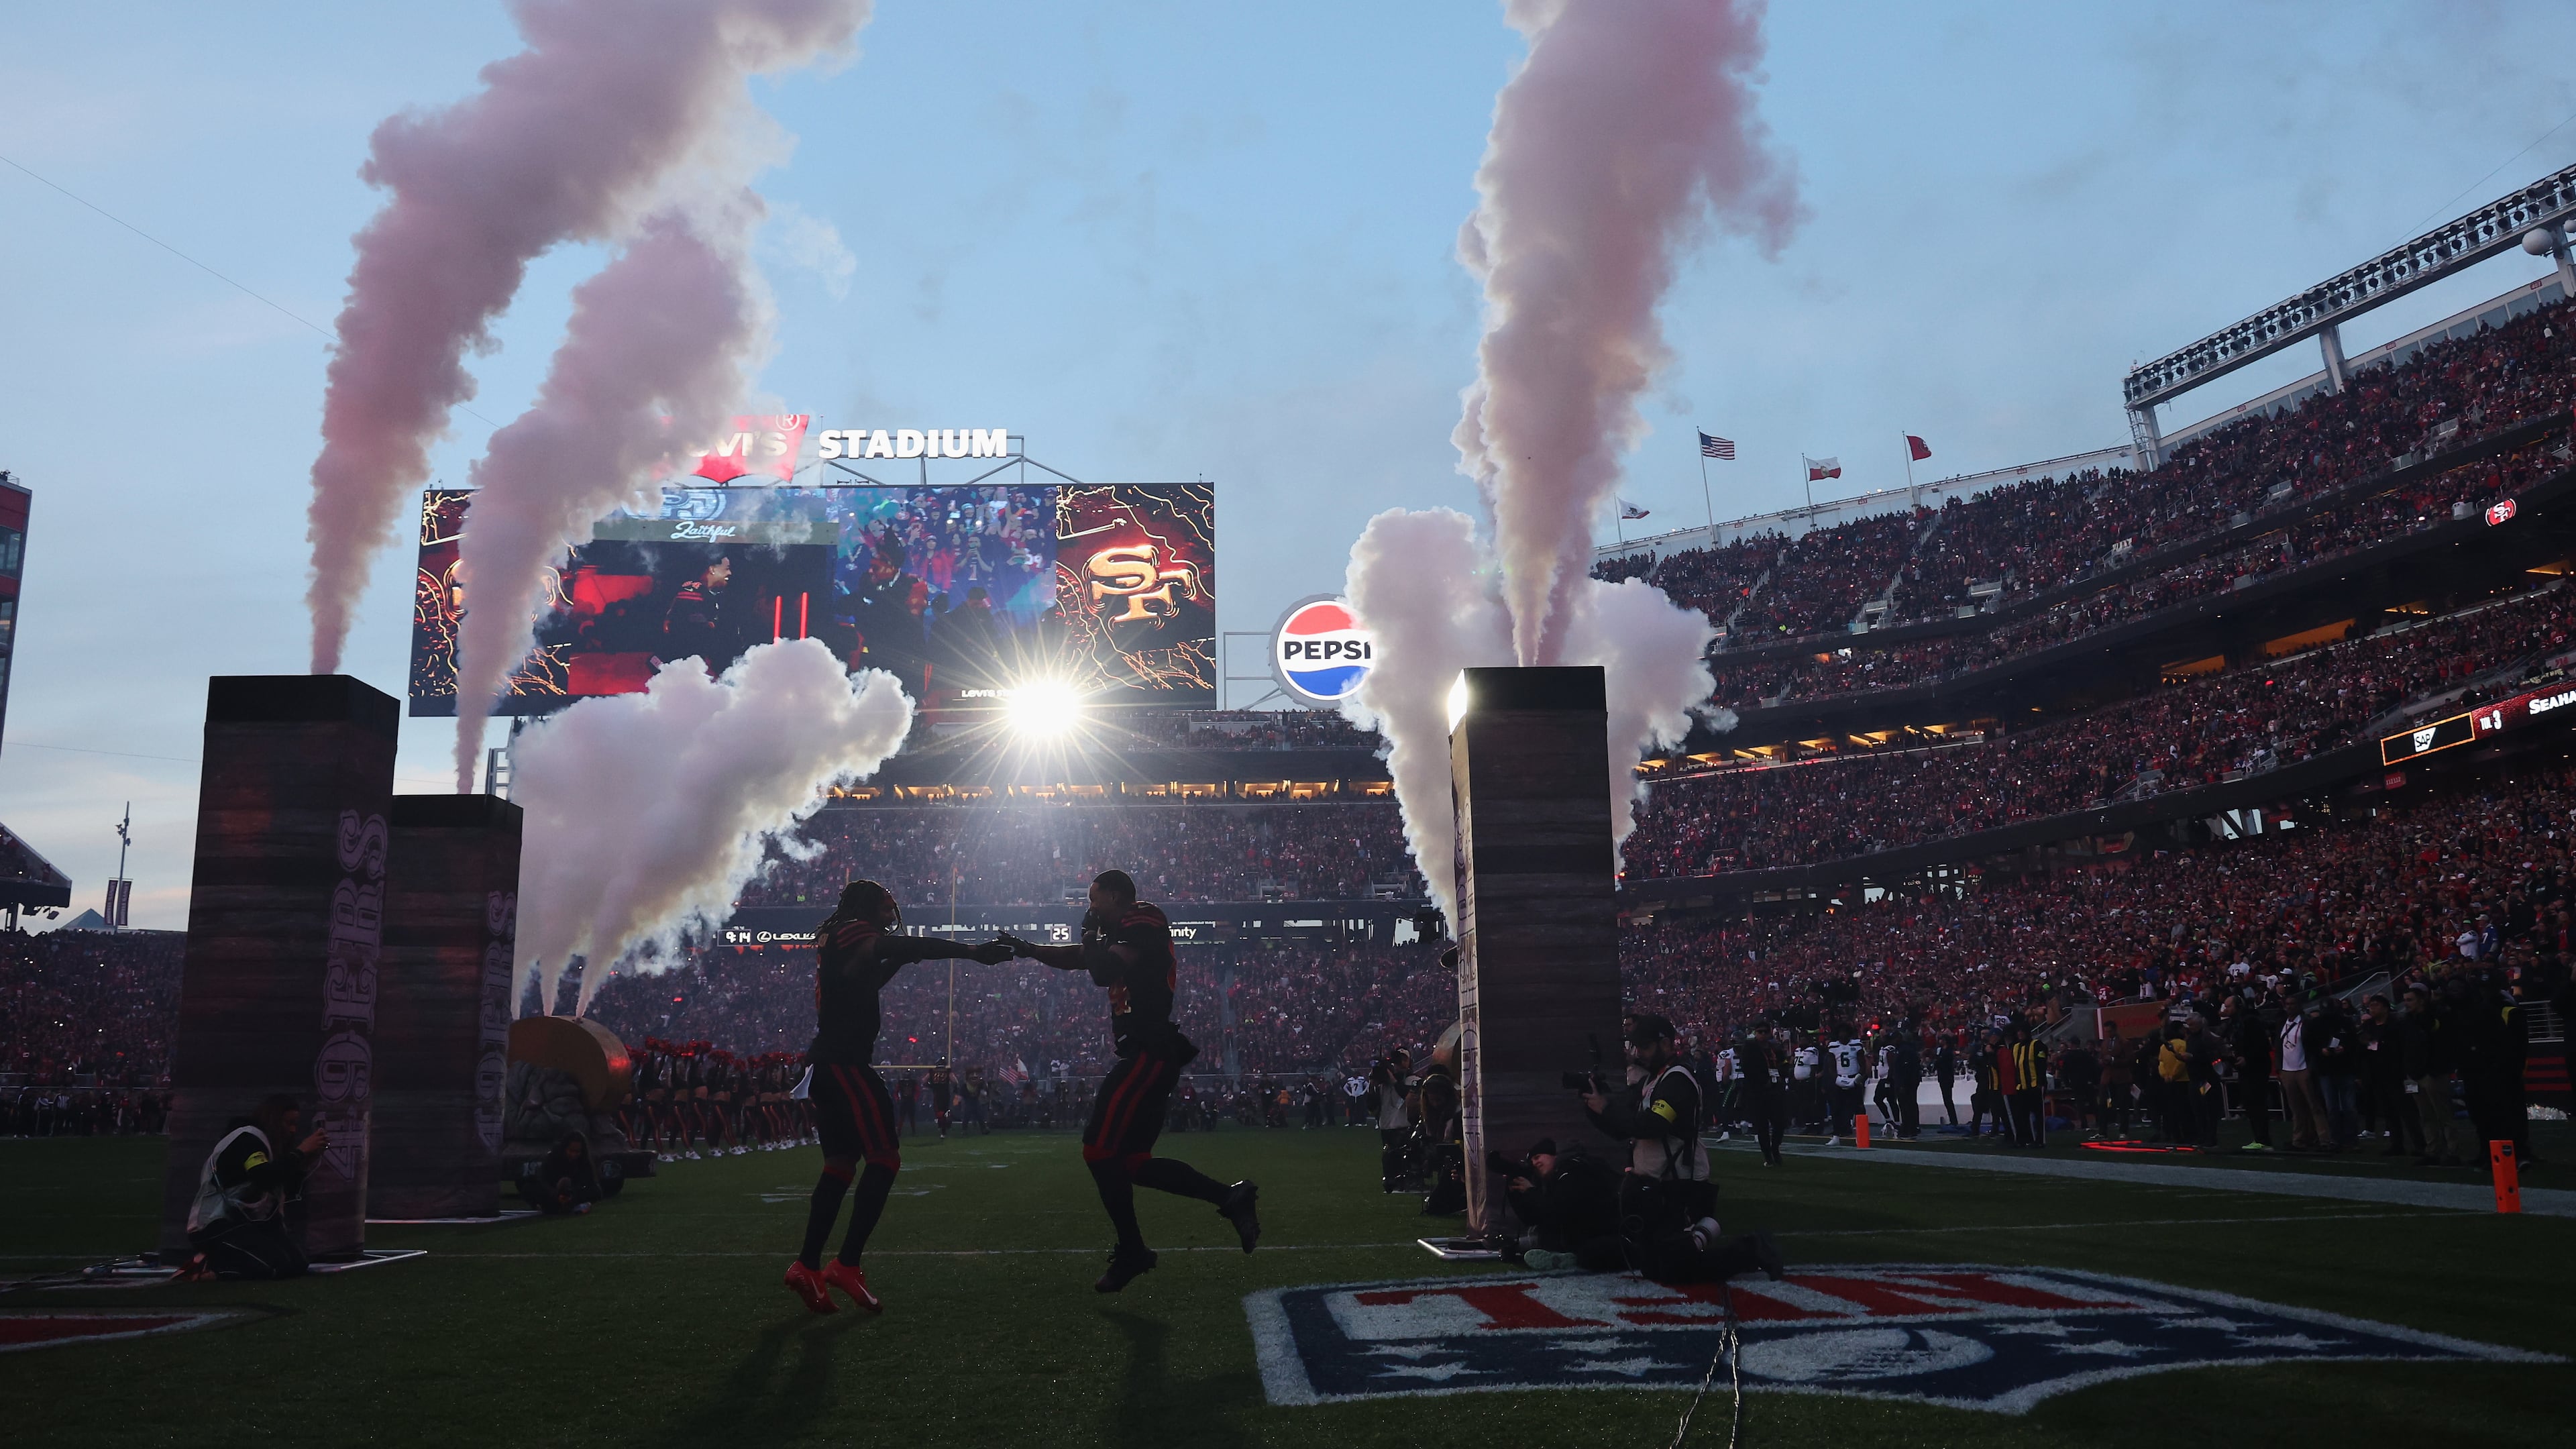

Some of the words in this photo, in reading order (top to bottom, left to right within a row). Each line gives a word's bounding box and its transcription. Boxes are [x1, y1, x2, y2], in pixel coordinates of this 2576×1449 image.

[818, 428, 1008, 460] STADIUM
[671, 521, 735, 543] Faithful
[1284, 640, 1371, 660] PEPSI
[2415, 733, 2431, 747] SAP
[725, 931, 751, 943] 9:14
[773, 932, 816, 941] LEXUS
[1053, 928, 1069, 940] 25
[1168, 924, 1197, 938] inity
[1840, 1052, 1850, 1068] 6
